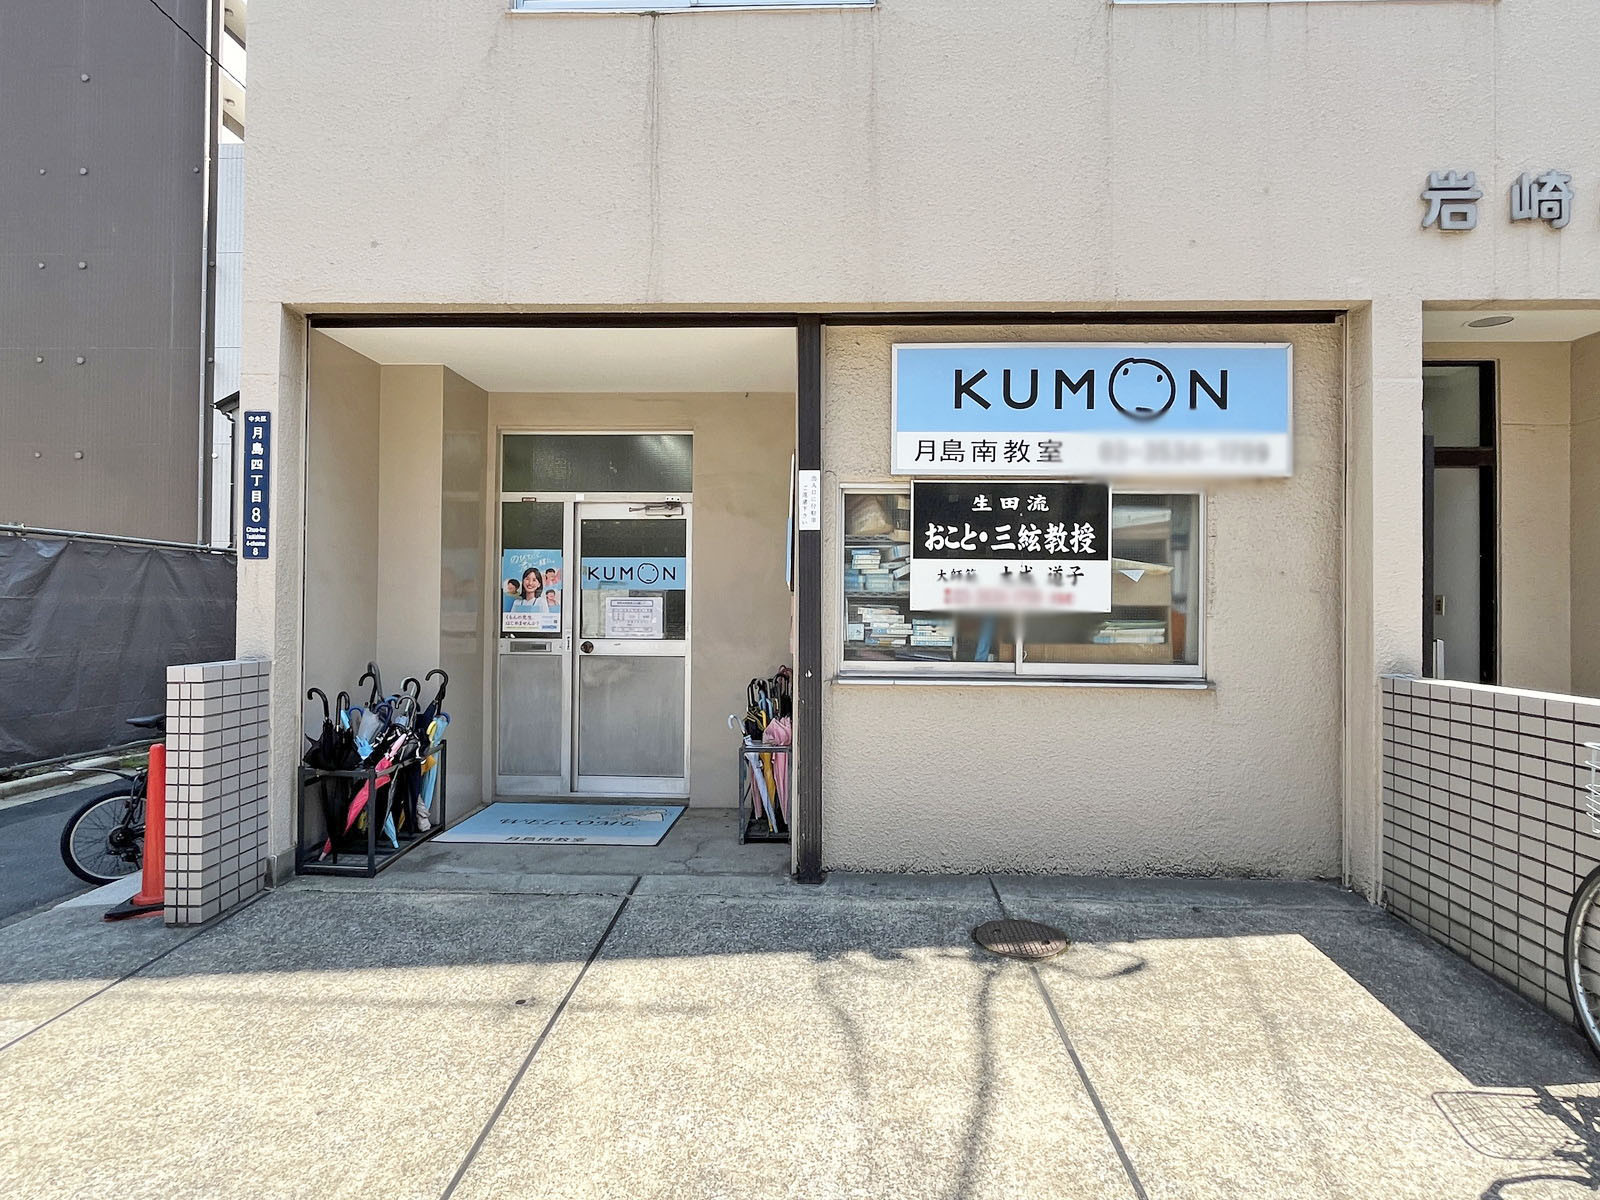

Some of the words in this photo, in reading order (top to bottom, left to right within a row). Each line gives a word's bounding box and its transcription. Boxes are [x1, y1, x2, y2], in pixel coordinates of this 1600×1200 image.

[1421, 169, 1574, 229] 岩崎
[953, 357, 1228, 420] KUMON
[914, 438, 1064, 464] 月島南教室
[971, 493, 1050, 512] 生田流
[252, 547, 259, 556] 8
[588, 562, 676, 584] KUMON
[499, 817, 640, 827] WELCOME
